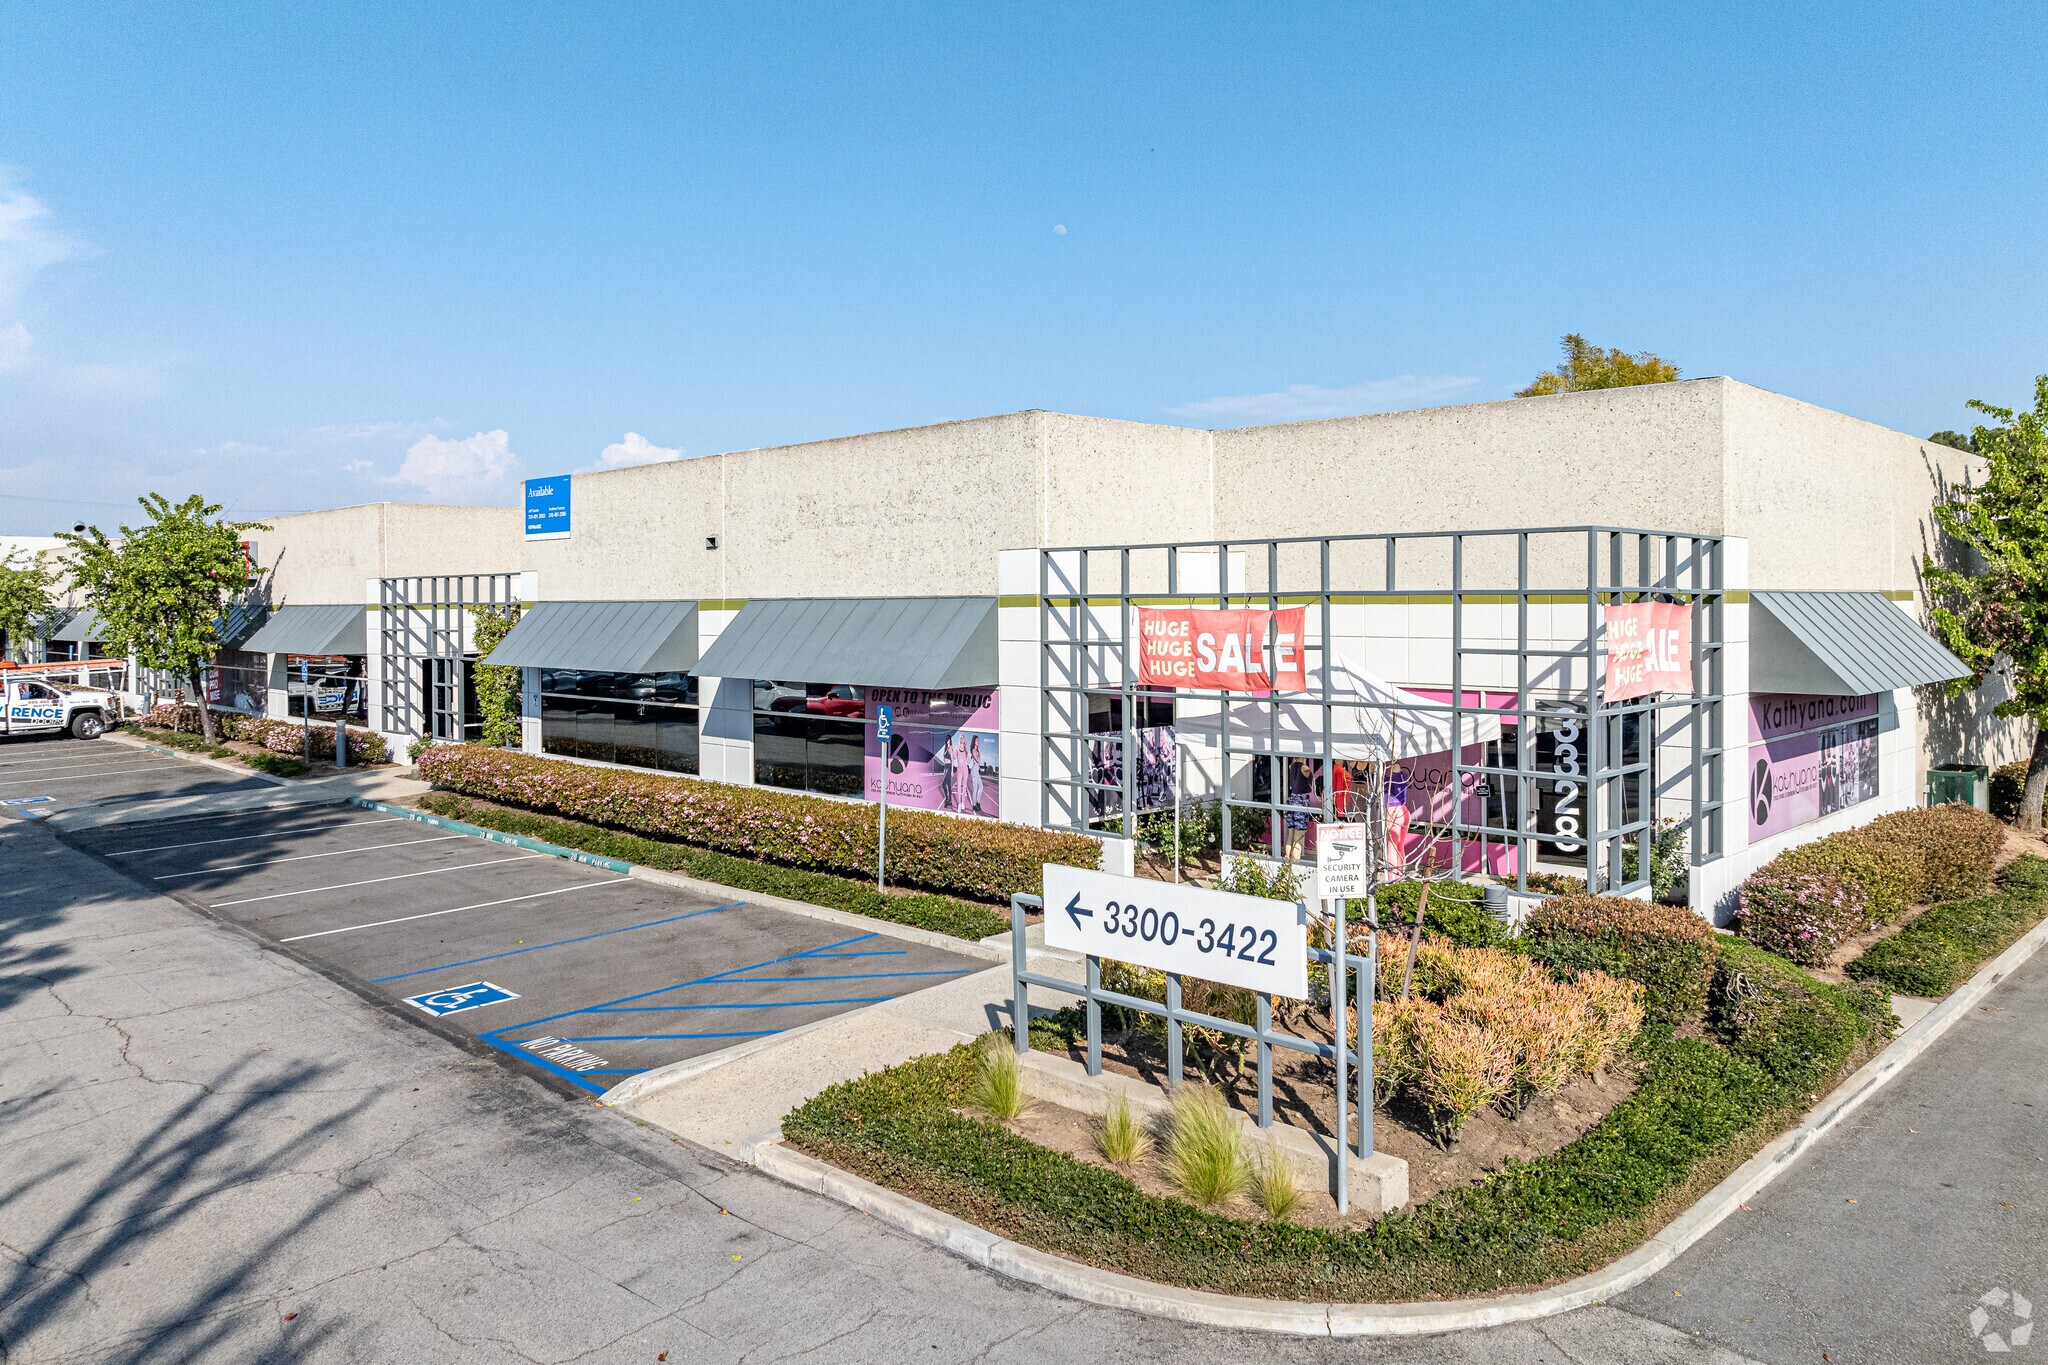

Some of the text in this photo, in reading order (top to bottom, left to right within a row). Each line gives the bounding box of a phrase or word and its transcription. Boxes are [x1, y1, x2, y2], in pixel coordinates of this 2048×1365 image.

[528, 485, 554, 498] Available
[1144, 620, 1190, 637] HUGE
[1147, 640, 1192, 656] HUGE
[1196, 632, 1298, 674] SALE
[1151, 660, 1196, 677] HUGE
[871, 689, 899, 702] OPEN
[903, 691, 918, 704] TO
[945, 692, 992, 709] PUBLIC
[1763, 695, 1867, 730] Kathyana.com
[870, 777, 923, 795] kahyana
[1553, 707, 1581, 853] 3328
[1773, 765, 1818, 795] kathyana
[479, 830, 485, 839] 20
[502, 836, 518, 846] PARKING
[1321, 828, 1363, 839] NOTICE
[570, 852, 611, 869] 20 MIN PARKING
[1323, 863, 1361, 872] SECURITY
[1325, 874, 1359, 883] CAMERA
[1339, 885, 1355, 893] USE
[1103, 901, 1278, 967] 3300-3422
[519, 1035, 609, 1072] NO PARKING
